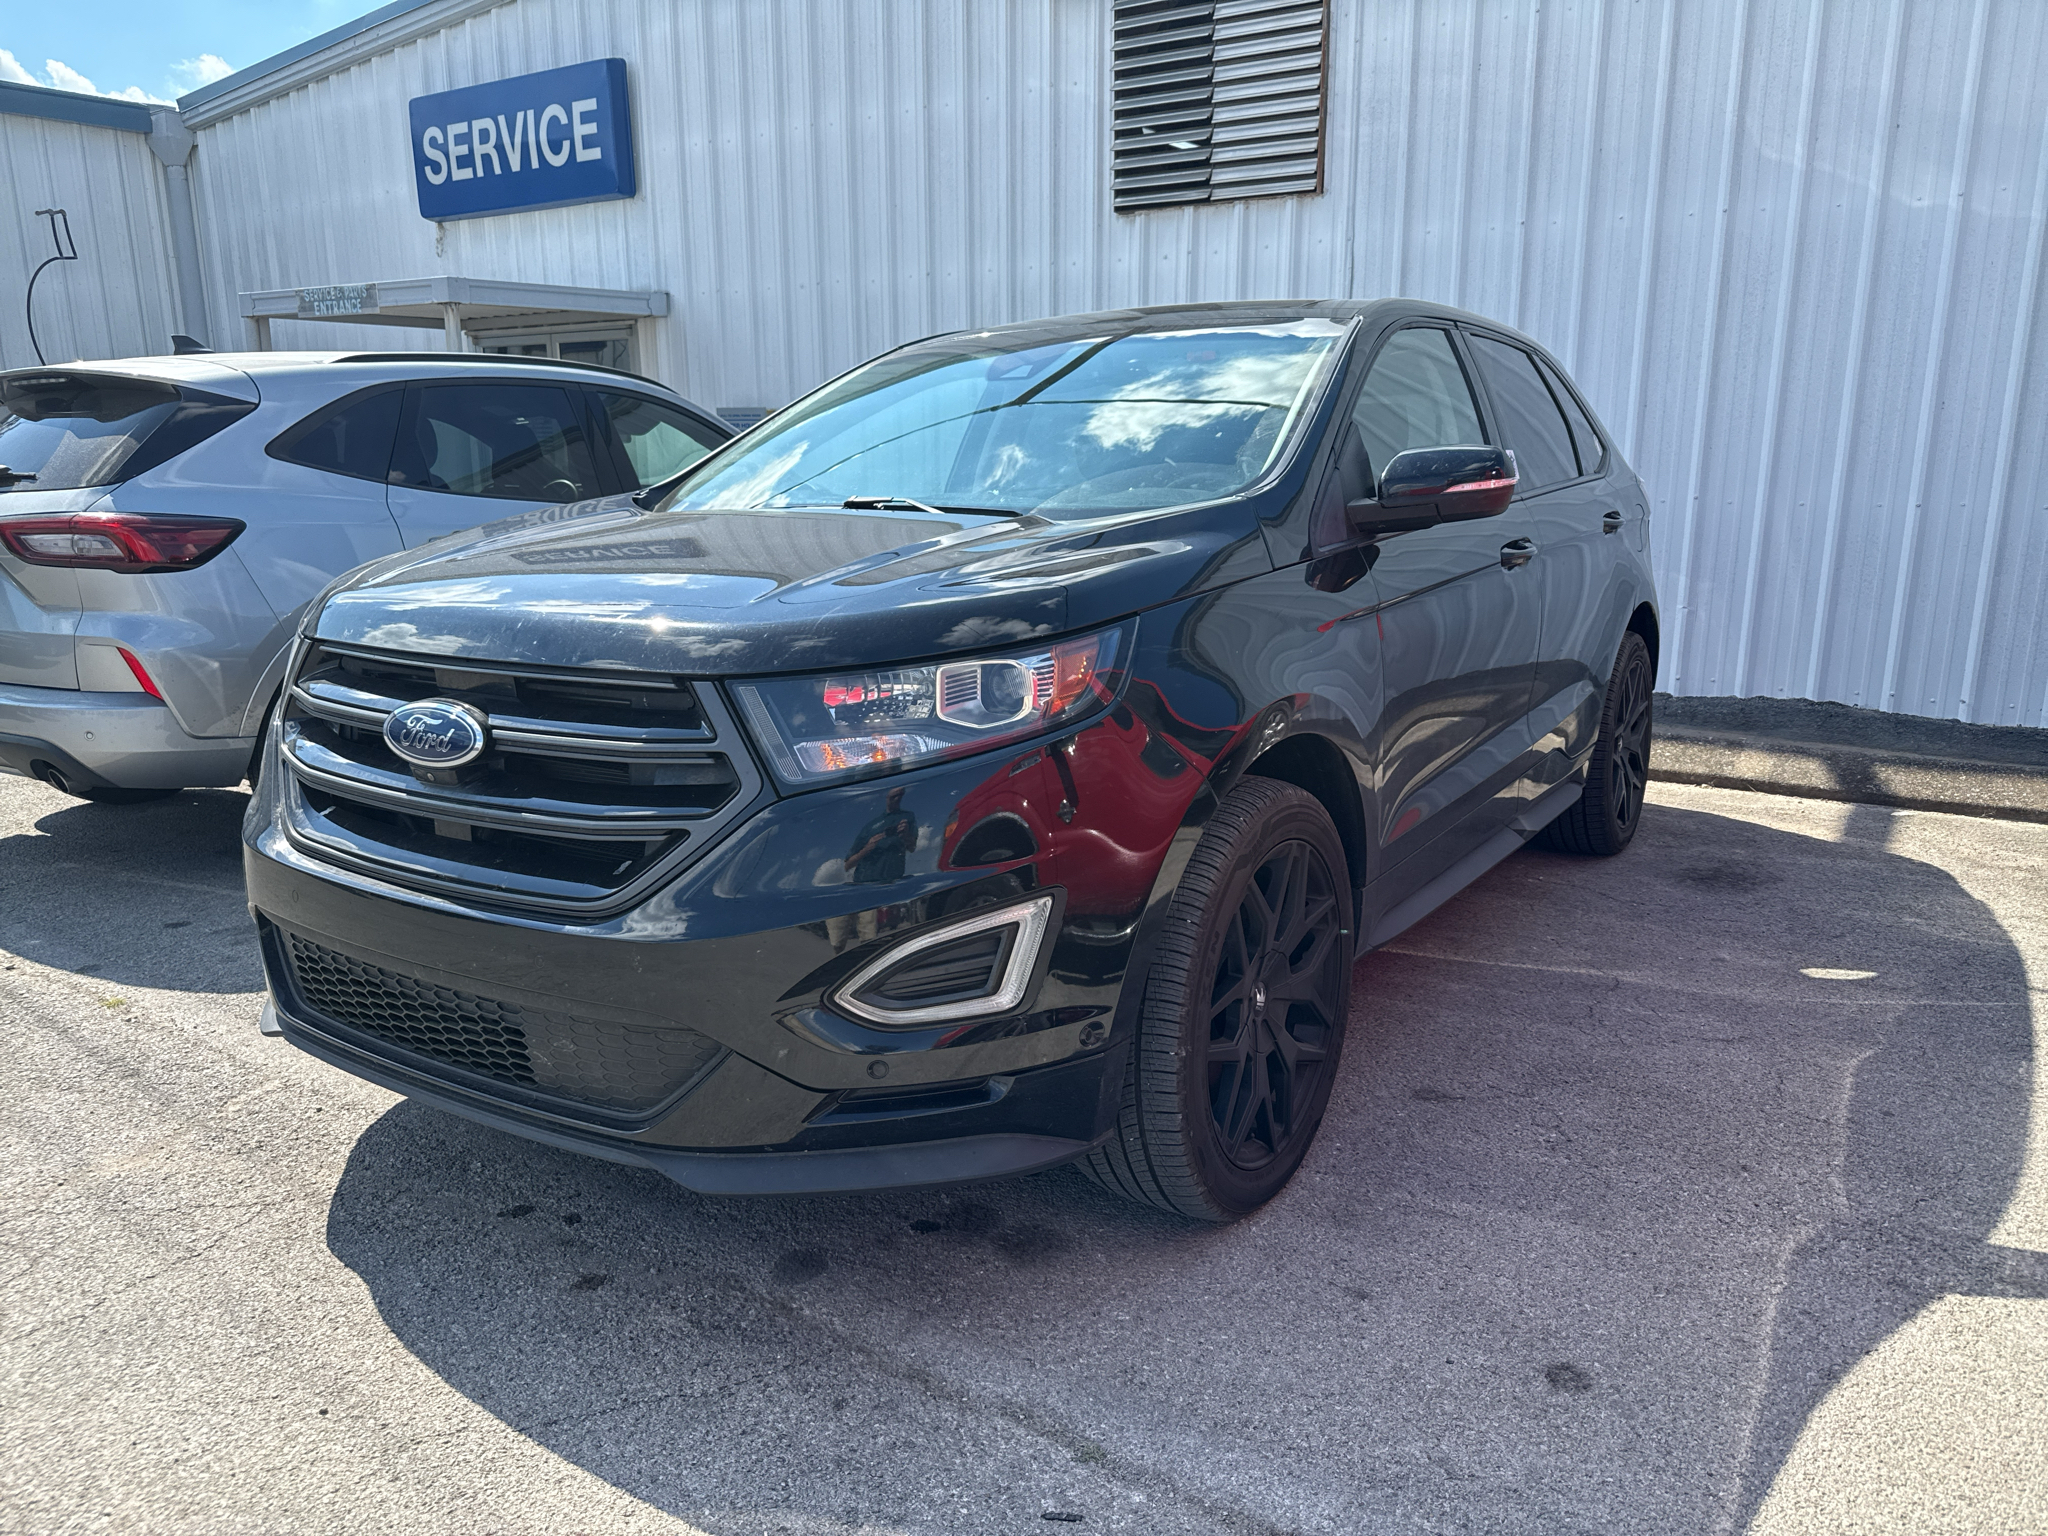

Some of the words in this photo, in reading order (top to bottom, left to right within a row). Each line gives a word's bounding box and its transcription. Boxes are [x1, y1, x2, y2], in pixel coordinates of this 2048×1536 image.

[422, 97, 602, 186] SERVICE
[304, 287, 335, 302] SERVICE
[344, 284, 367, 299] PARTS
[313, 299, 362, 316] ENTRANCE
[400, 714, 455, 752] Ford
